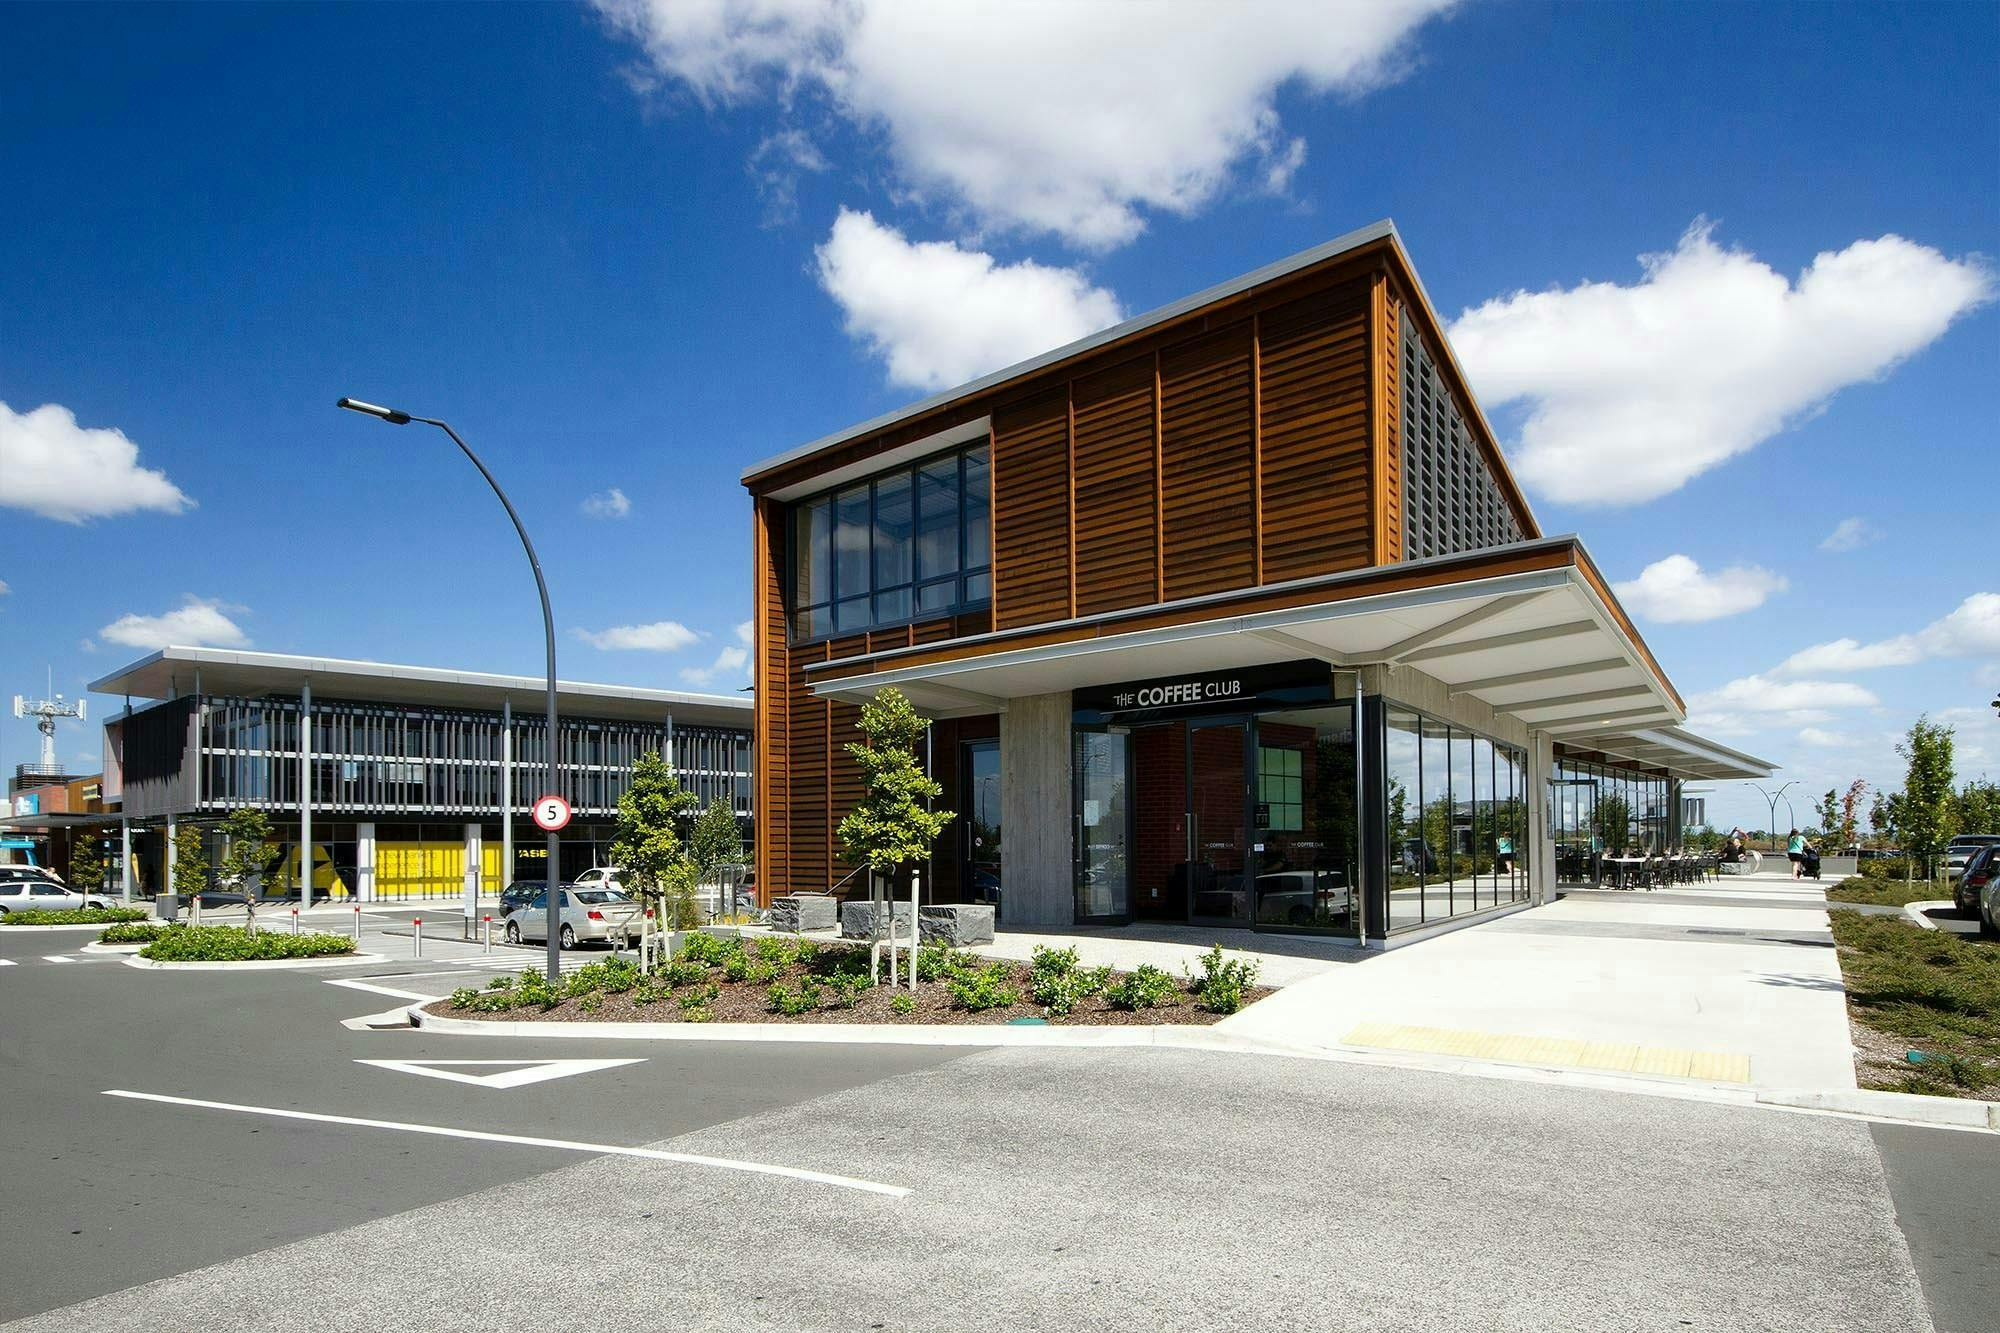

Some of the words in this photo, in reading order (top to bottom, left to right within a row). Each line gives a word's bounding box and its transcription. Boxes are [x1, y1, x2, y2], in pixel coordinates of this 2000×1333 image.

[1113, 693, 1136, 707] THE
[1138, 682, 1202, 707] COFFEE
[1205, 680, 1241, 697] CLUB
[547, 805, 557, 821] 5
